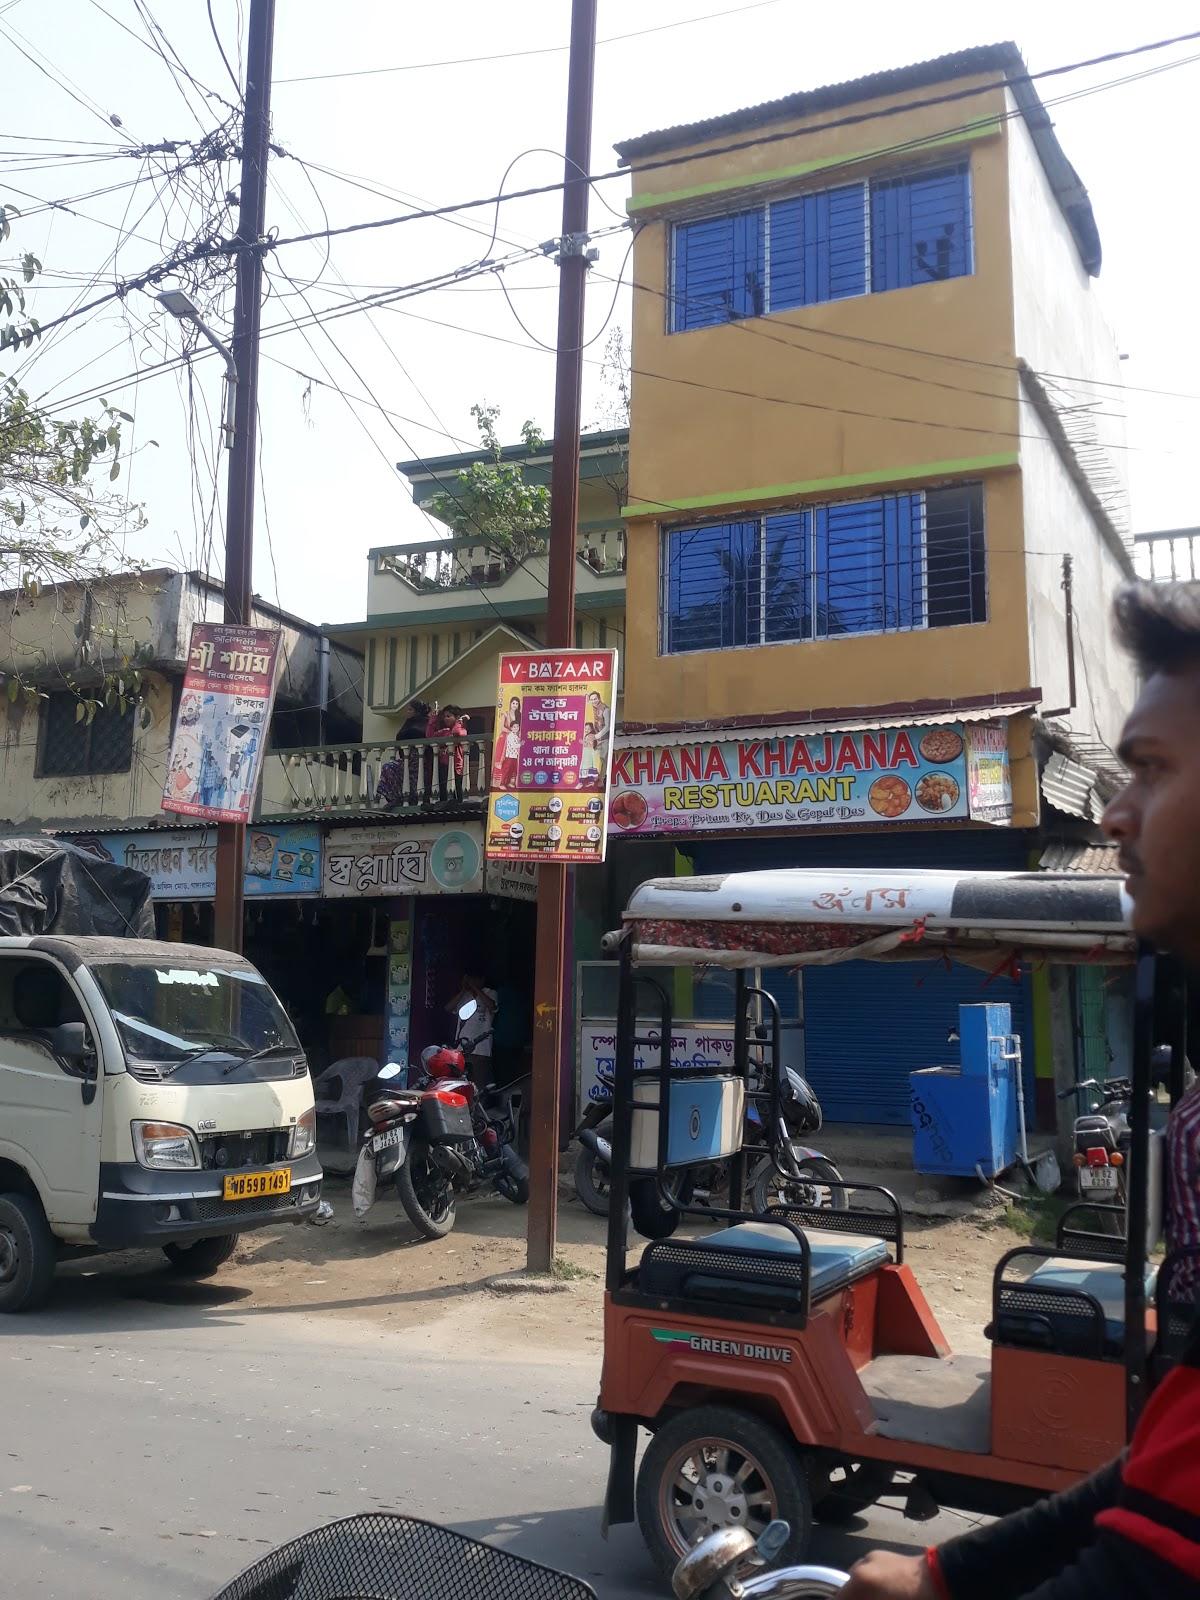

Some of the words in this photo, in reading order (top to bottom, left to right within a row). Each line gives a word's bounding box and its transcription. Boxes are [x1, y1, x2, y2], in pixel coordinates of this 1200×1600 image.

[190, 641, 216, 673] শ্রী
[219, 650, 271, 675] শ্যাম
[508, 661, 604, 679] V-BAZAAR
[235, 696, 265, 709] উপহার
[610, 743, 729, 788] KHANA
[737, 731, 919, 779] KHAJANA
[663, 776, 857, 811] RESTUARANT
[784, 809, 798, 821] &
[198, 1119, 217, 1130] ACE
[689, 1336, 741, 1356] GREEN
[743, 1343, 793, 1363] DRIVE
